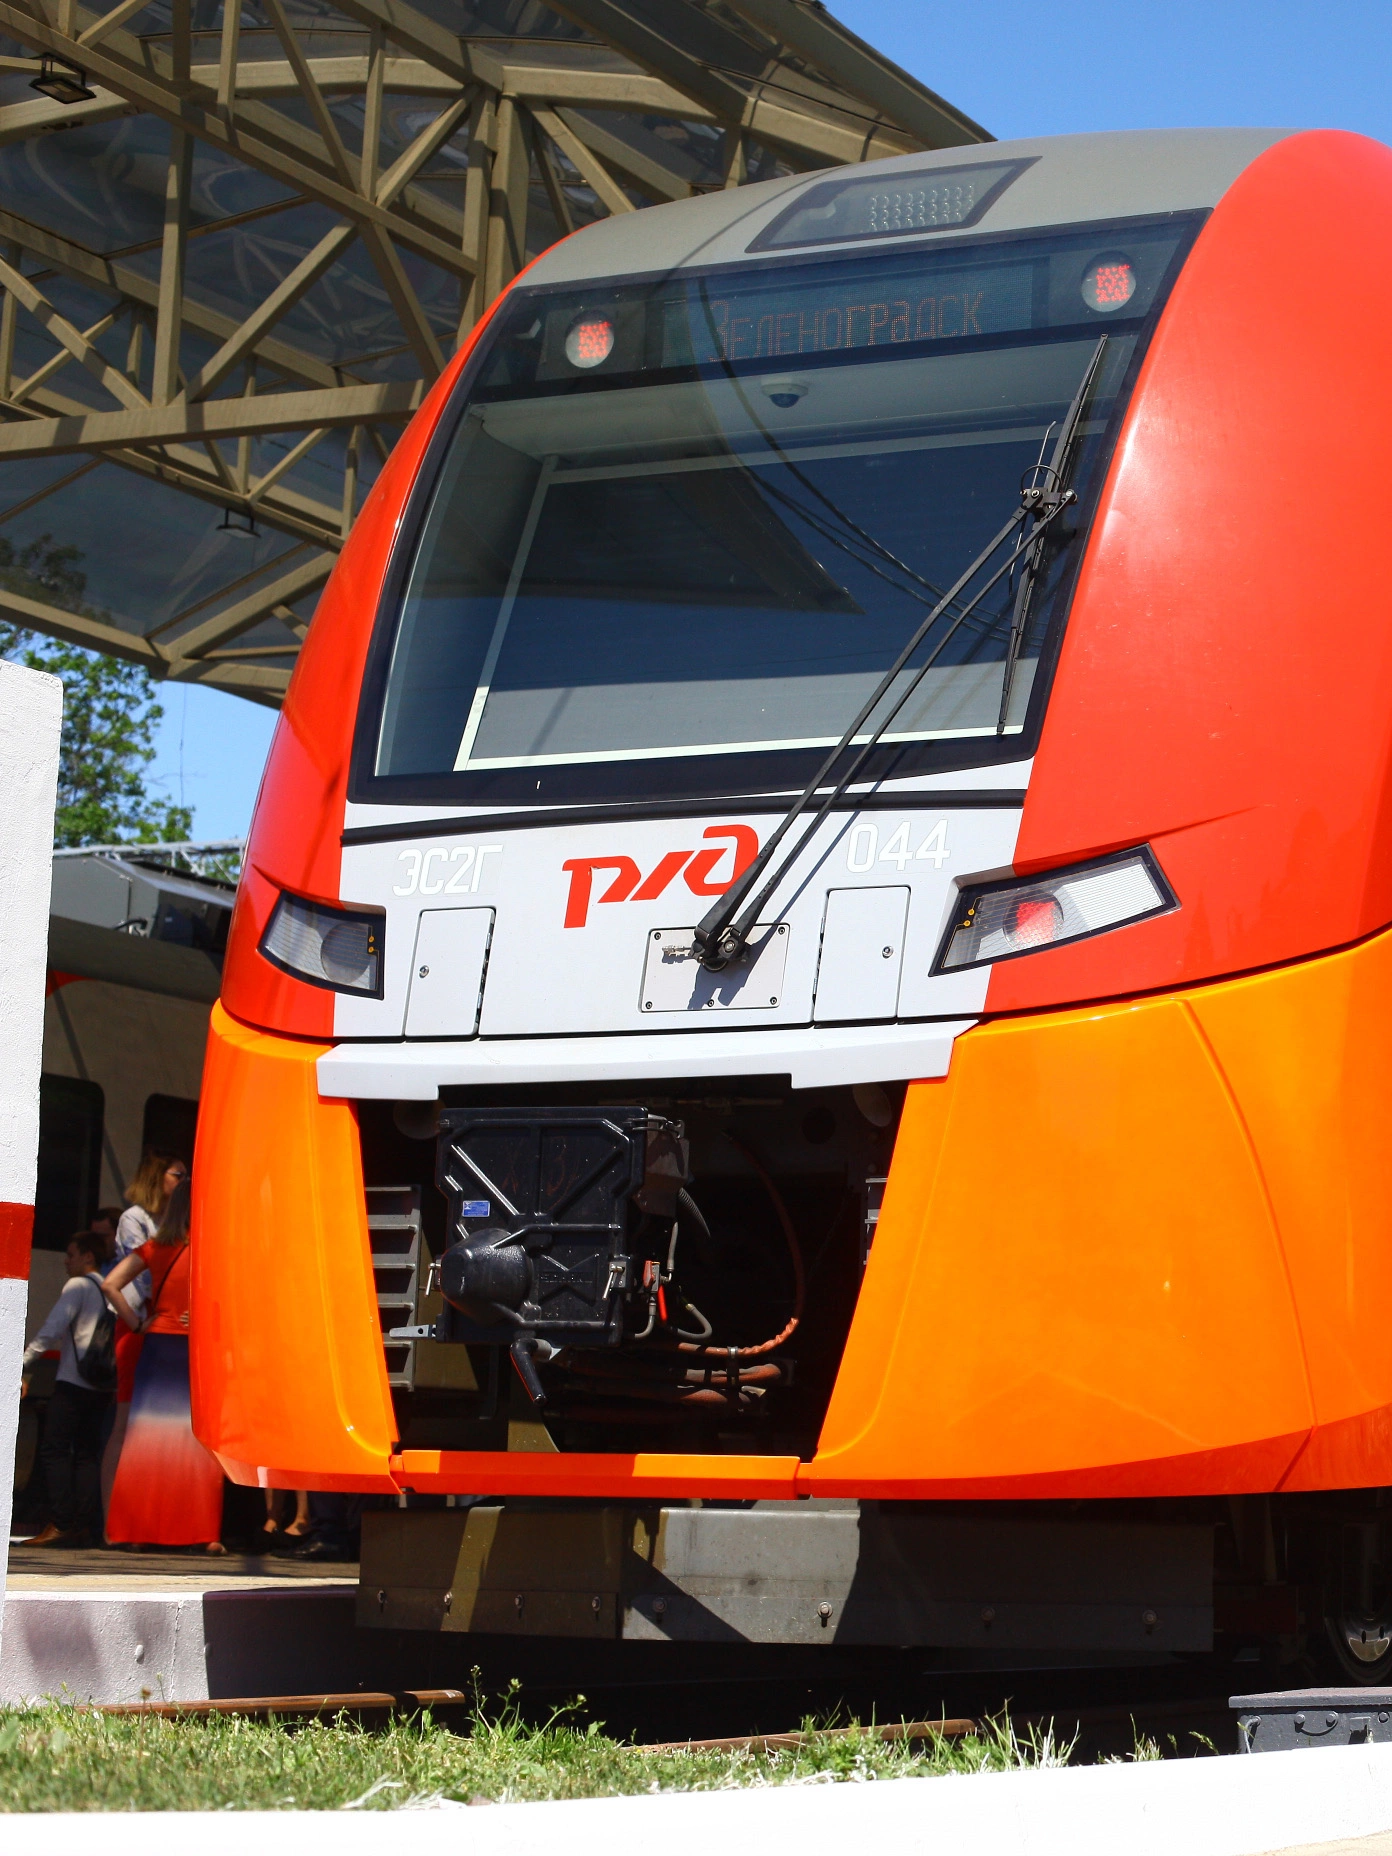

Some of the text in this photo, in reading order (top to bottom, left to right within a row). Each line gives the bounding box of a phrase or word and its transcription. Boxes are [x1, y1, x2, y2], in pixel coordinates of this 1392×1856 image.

[392, 843, 504, 897] ЭС2Г
[845, 819, 952, 873] 044
[562, 824, 760, 928] РЖД
